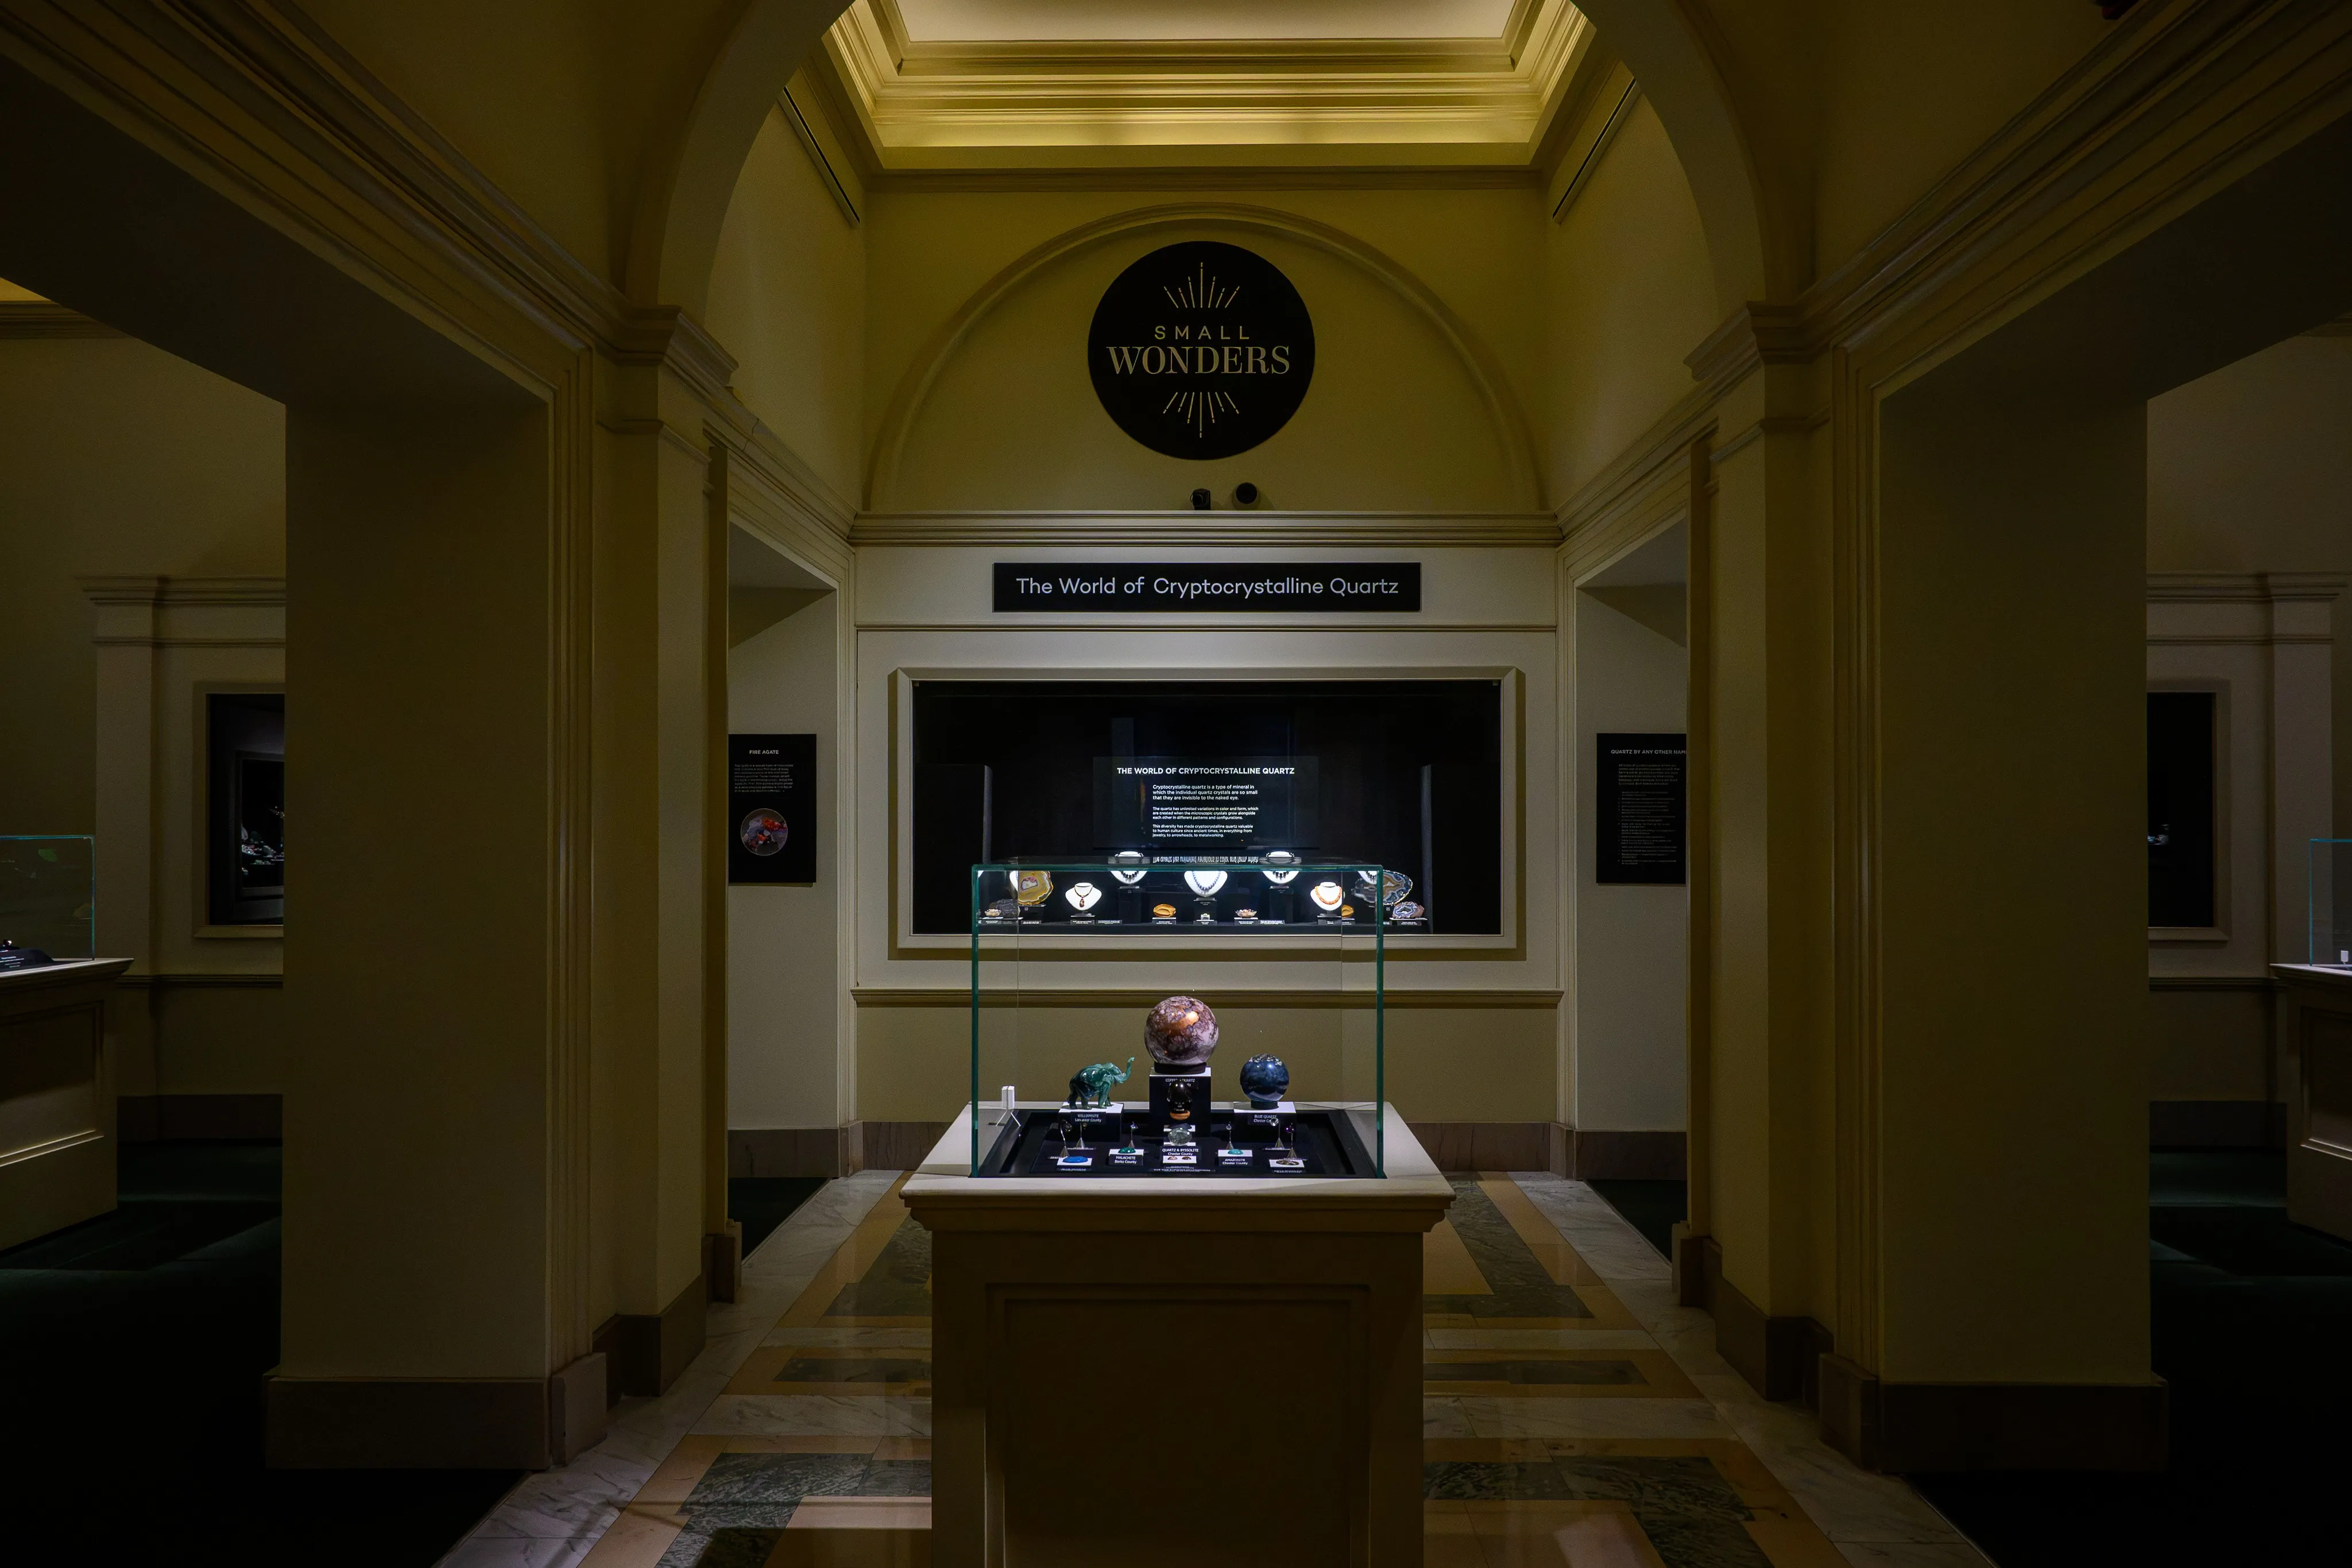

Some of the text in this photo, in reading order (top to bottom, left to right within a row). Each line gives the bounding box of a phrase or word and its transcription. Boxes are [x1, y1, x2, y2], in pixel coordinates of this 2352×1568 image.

[1154, 326, 1250, 340] SMALL
[1106, 346, 1290, 375] WONDERS
[1016, 576, 1398, 599] The World of Cryptocrystalline Quartz
